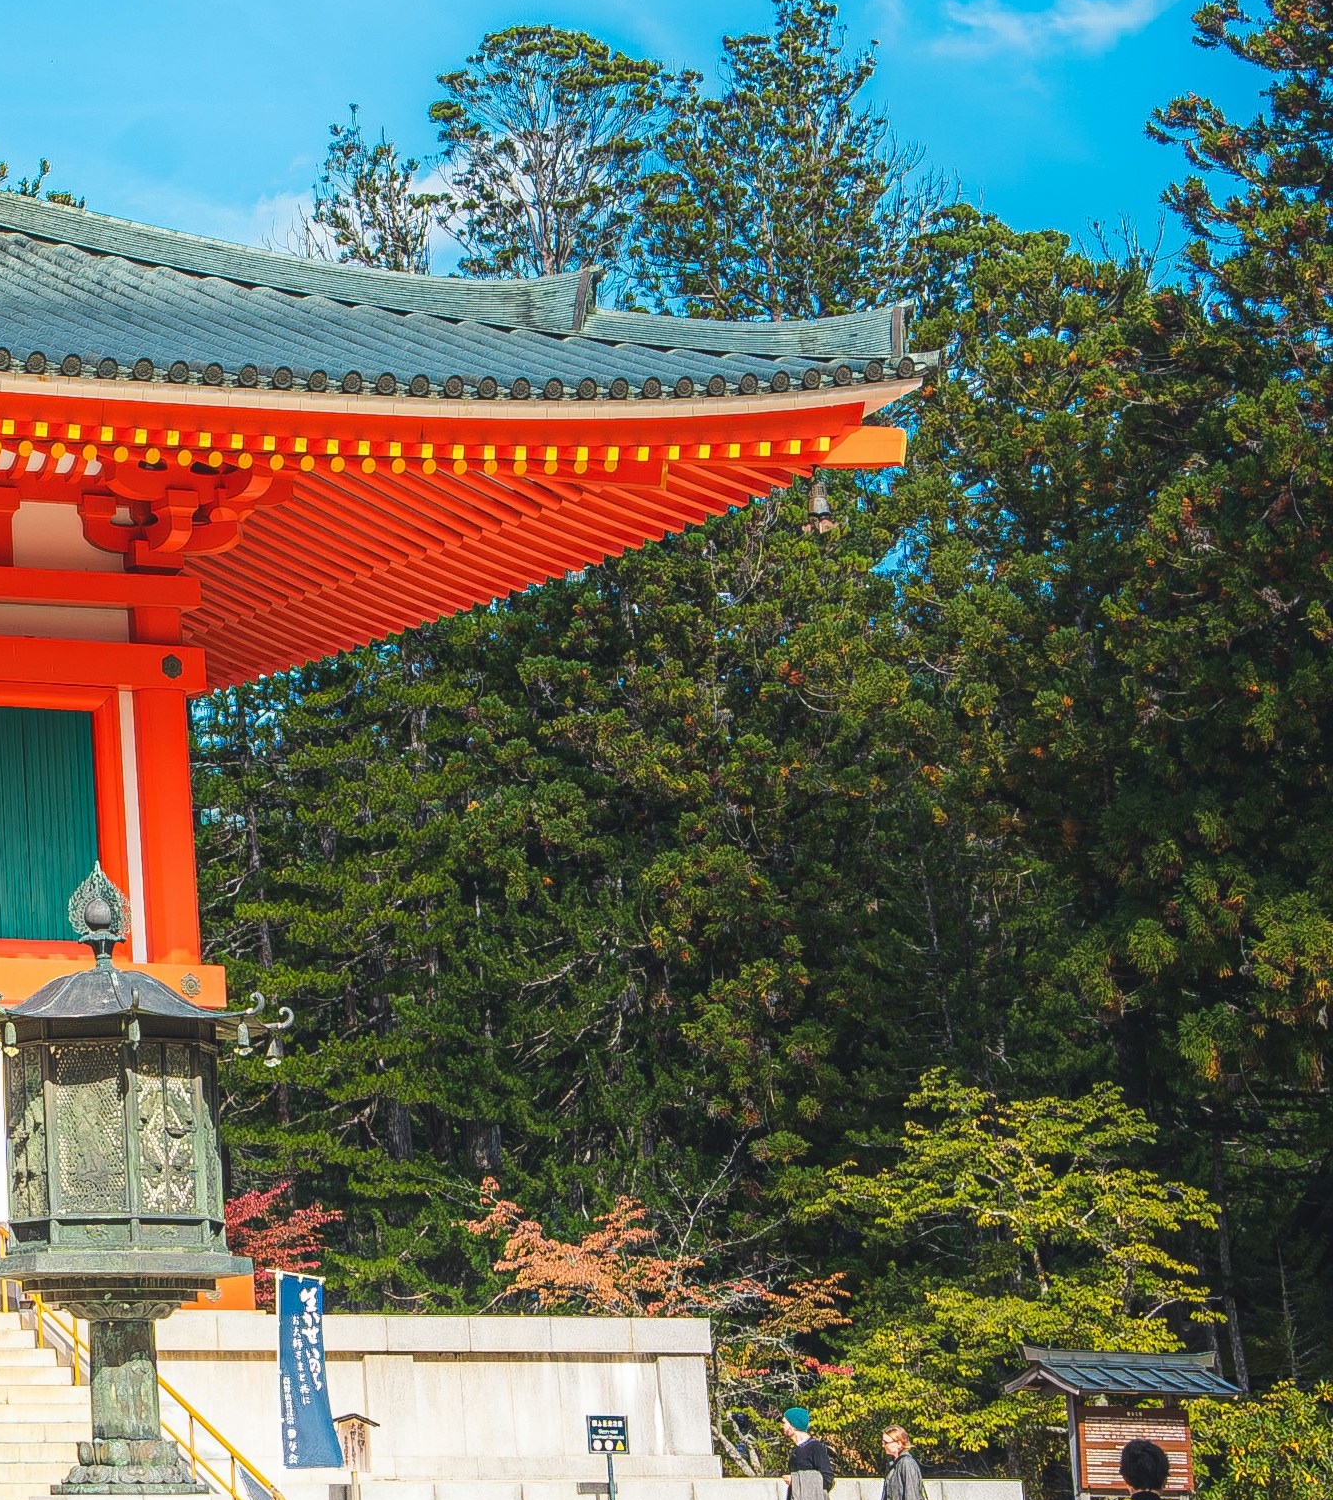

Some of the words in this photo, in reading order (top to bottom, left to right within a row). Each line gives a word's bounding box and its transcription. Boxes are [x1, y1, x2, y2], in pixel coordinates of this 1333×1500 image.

[292, 1315, 311, 1406] お大師さまと共に
[299, 1287, 322, 1391] 生かせいのち
